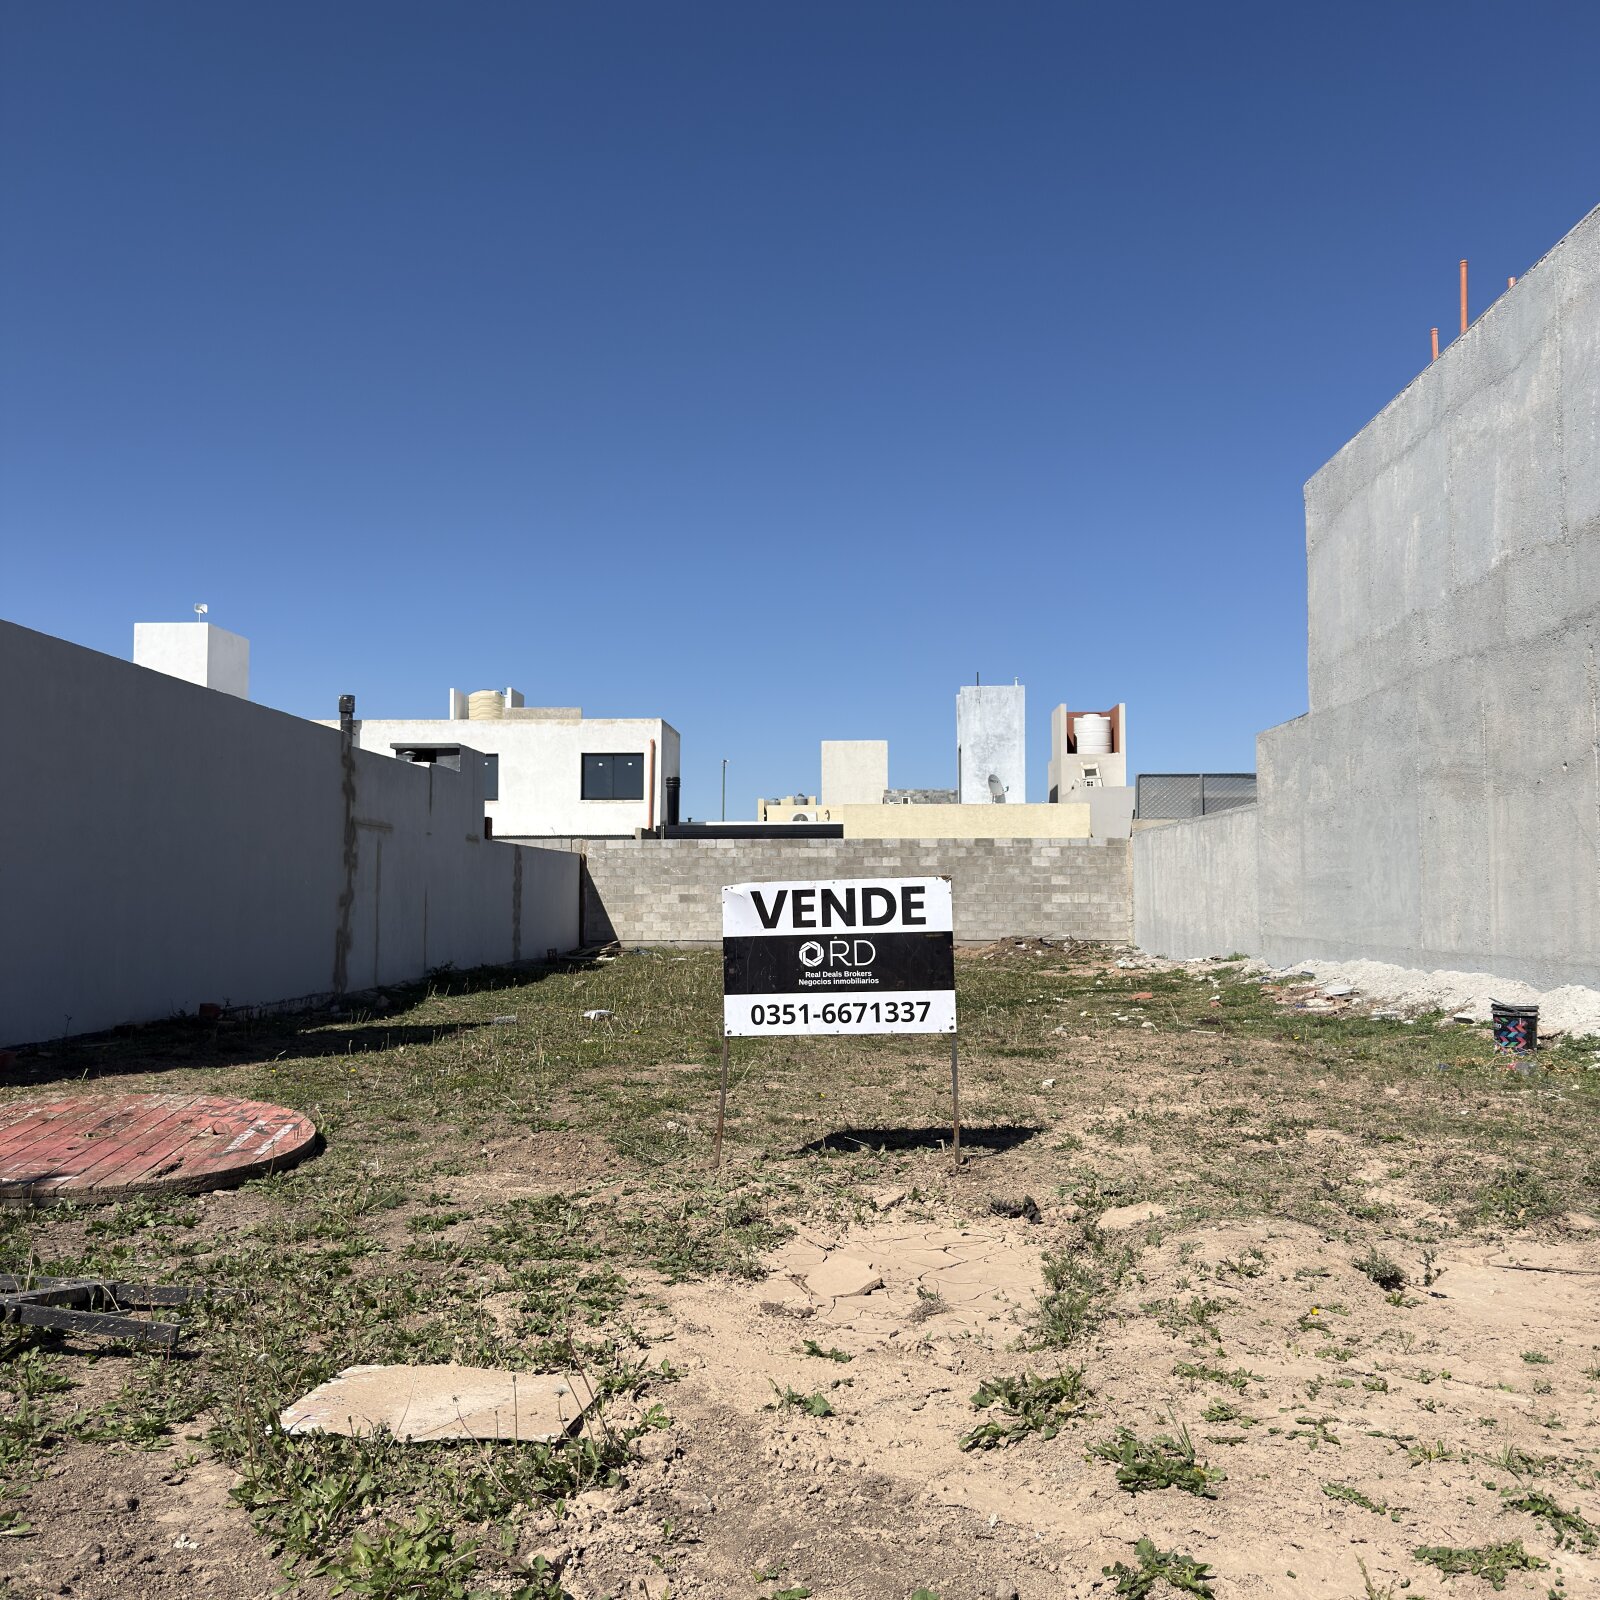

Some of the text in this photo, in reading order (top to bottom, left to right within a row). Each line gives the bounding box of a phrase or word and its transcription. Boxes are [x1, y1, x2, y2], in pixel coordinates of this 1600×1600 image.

[750, 886, 926, 929] VENDE
[805, 969, 872, 978] Real Deals Brokers
[798, 978, 832, 987] Negocios
[750, 1001, 931, 1026] 0351-6671337
